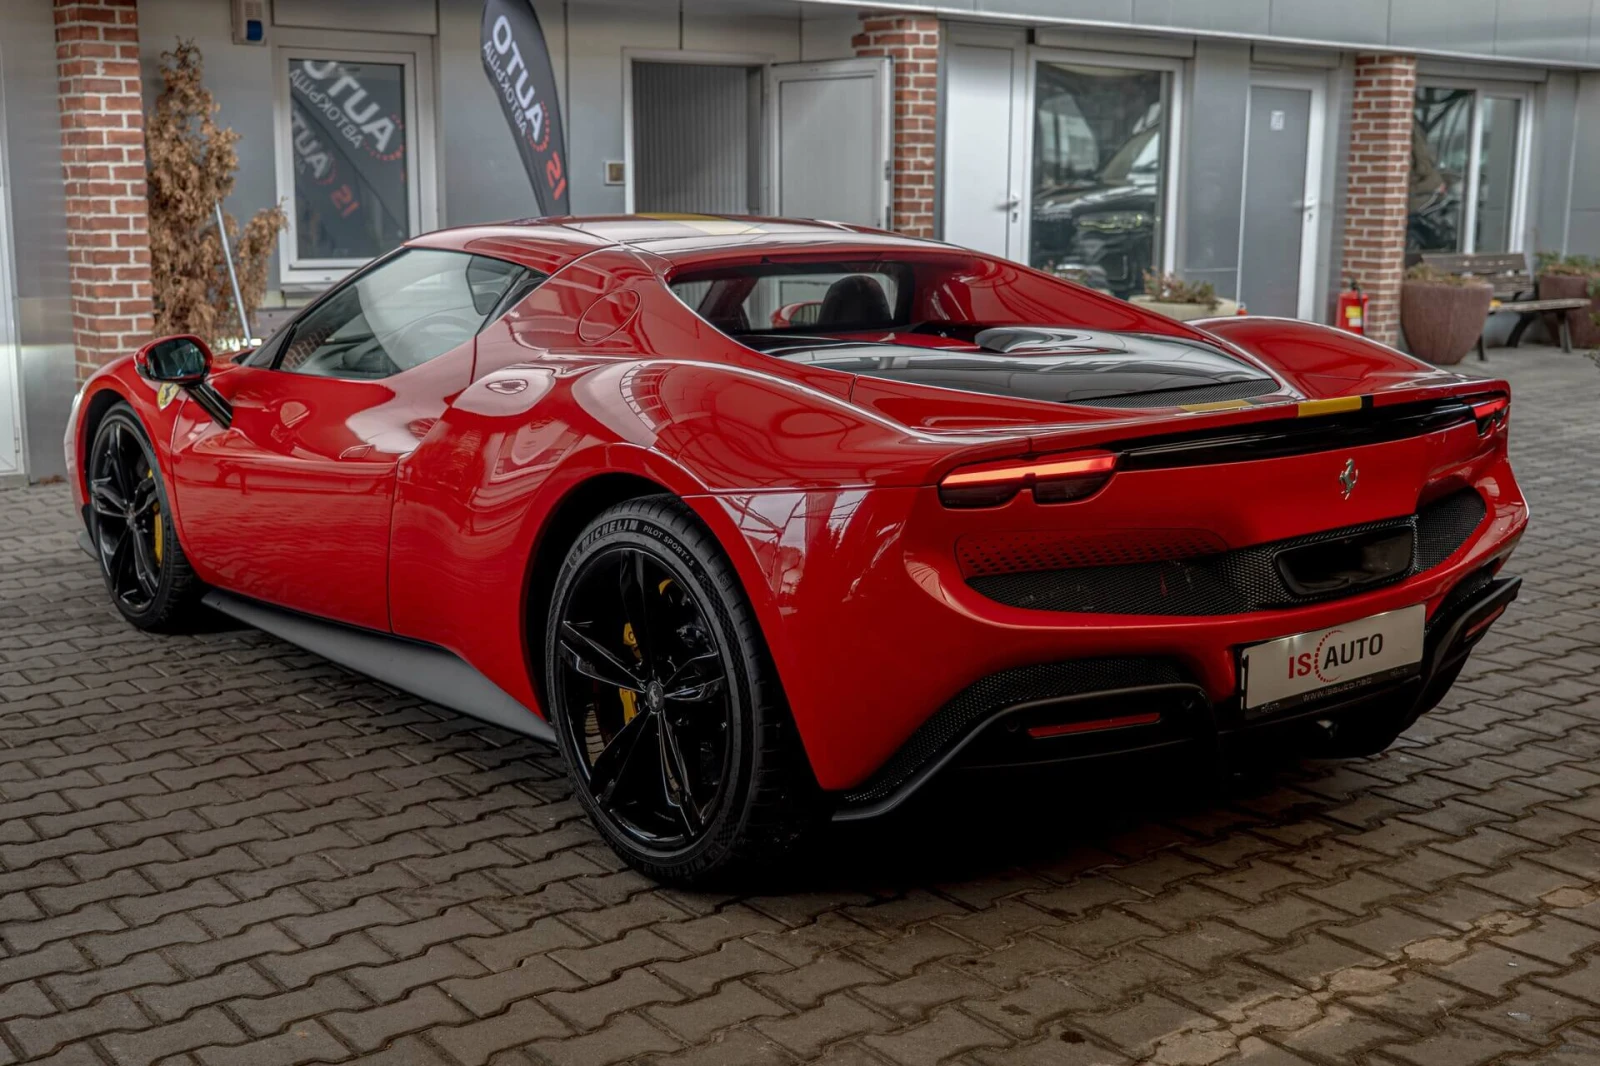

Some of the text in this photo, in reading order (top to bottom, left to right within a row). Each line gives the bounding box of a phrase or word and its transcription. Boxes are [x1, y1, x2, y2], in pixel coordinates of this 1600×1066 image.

[581, 519, 639, 552] MICHELIN
[643, 525, 664, 540] PILOT
[664, 535, 687, 558] SPORT
[1288, 633, 1384, 679] IS AUTO
